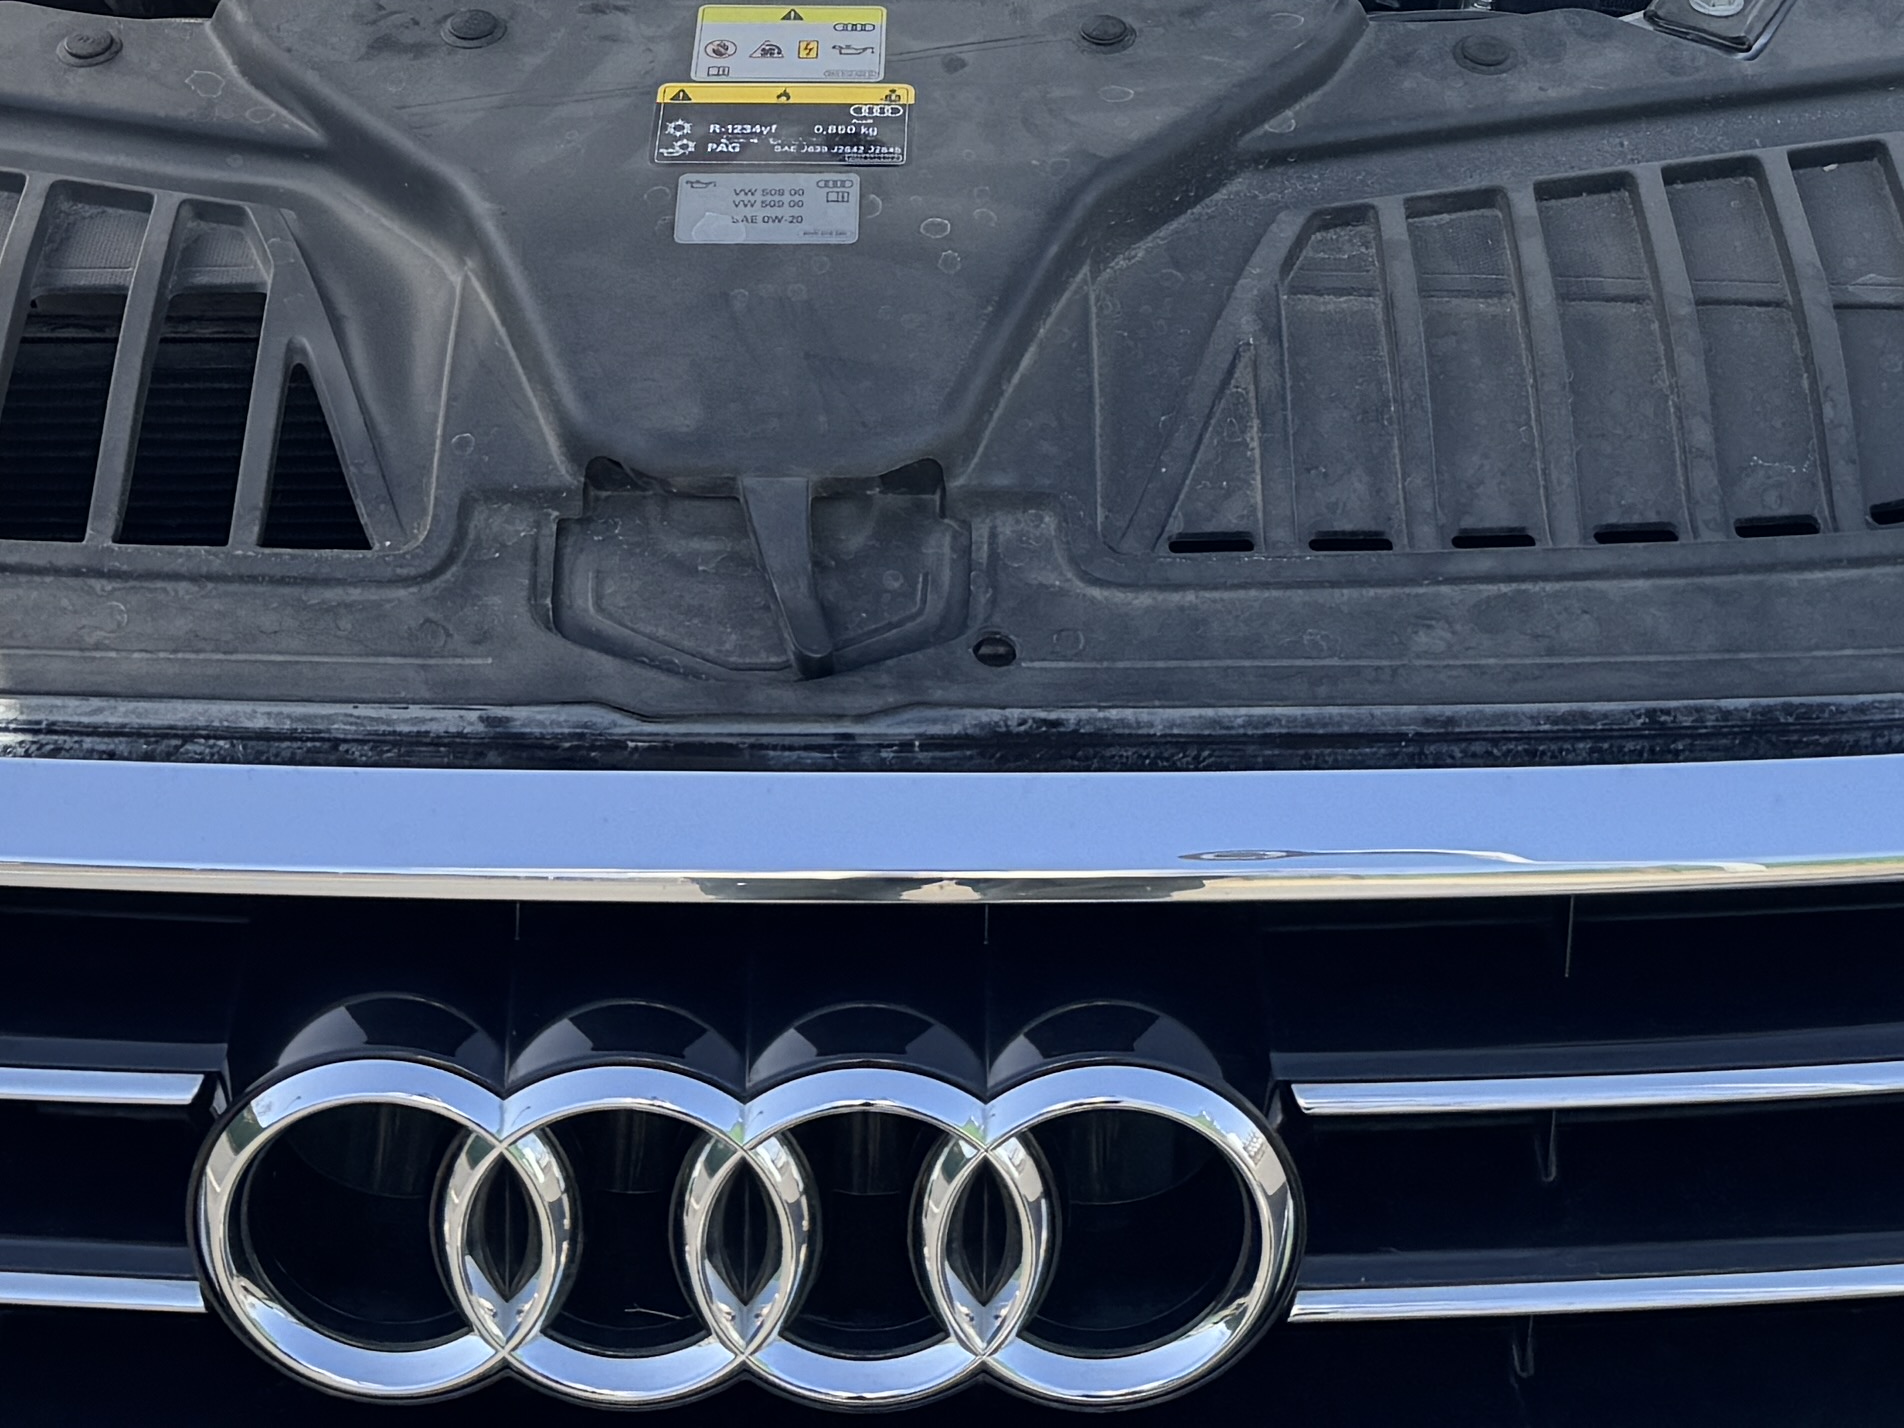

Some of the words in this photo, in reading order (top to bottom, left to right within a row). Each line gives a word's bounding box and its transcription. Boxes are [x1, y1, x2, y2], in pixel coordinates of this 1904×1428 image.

[709, 123, 778, 135] R-1234yf
[860, 124, 878, 136] kg
[707, 142, 740, 153] PAG
[733, 188, 758, 197] VW
[789, 188, 805, 197] 00
[732, 199, 757, 208] VW
[788, 199, 804, 208] 00
[762, 215, 804, 224] 0W-20
